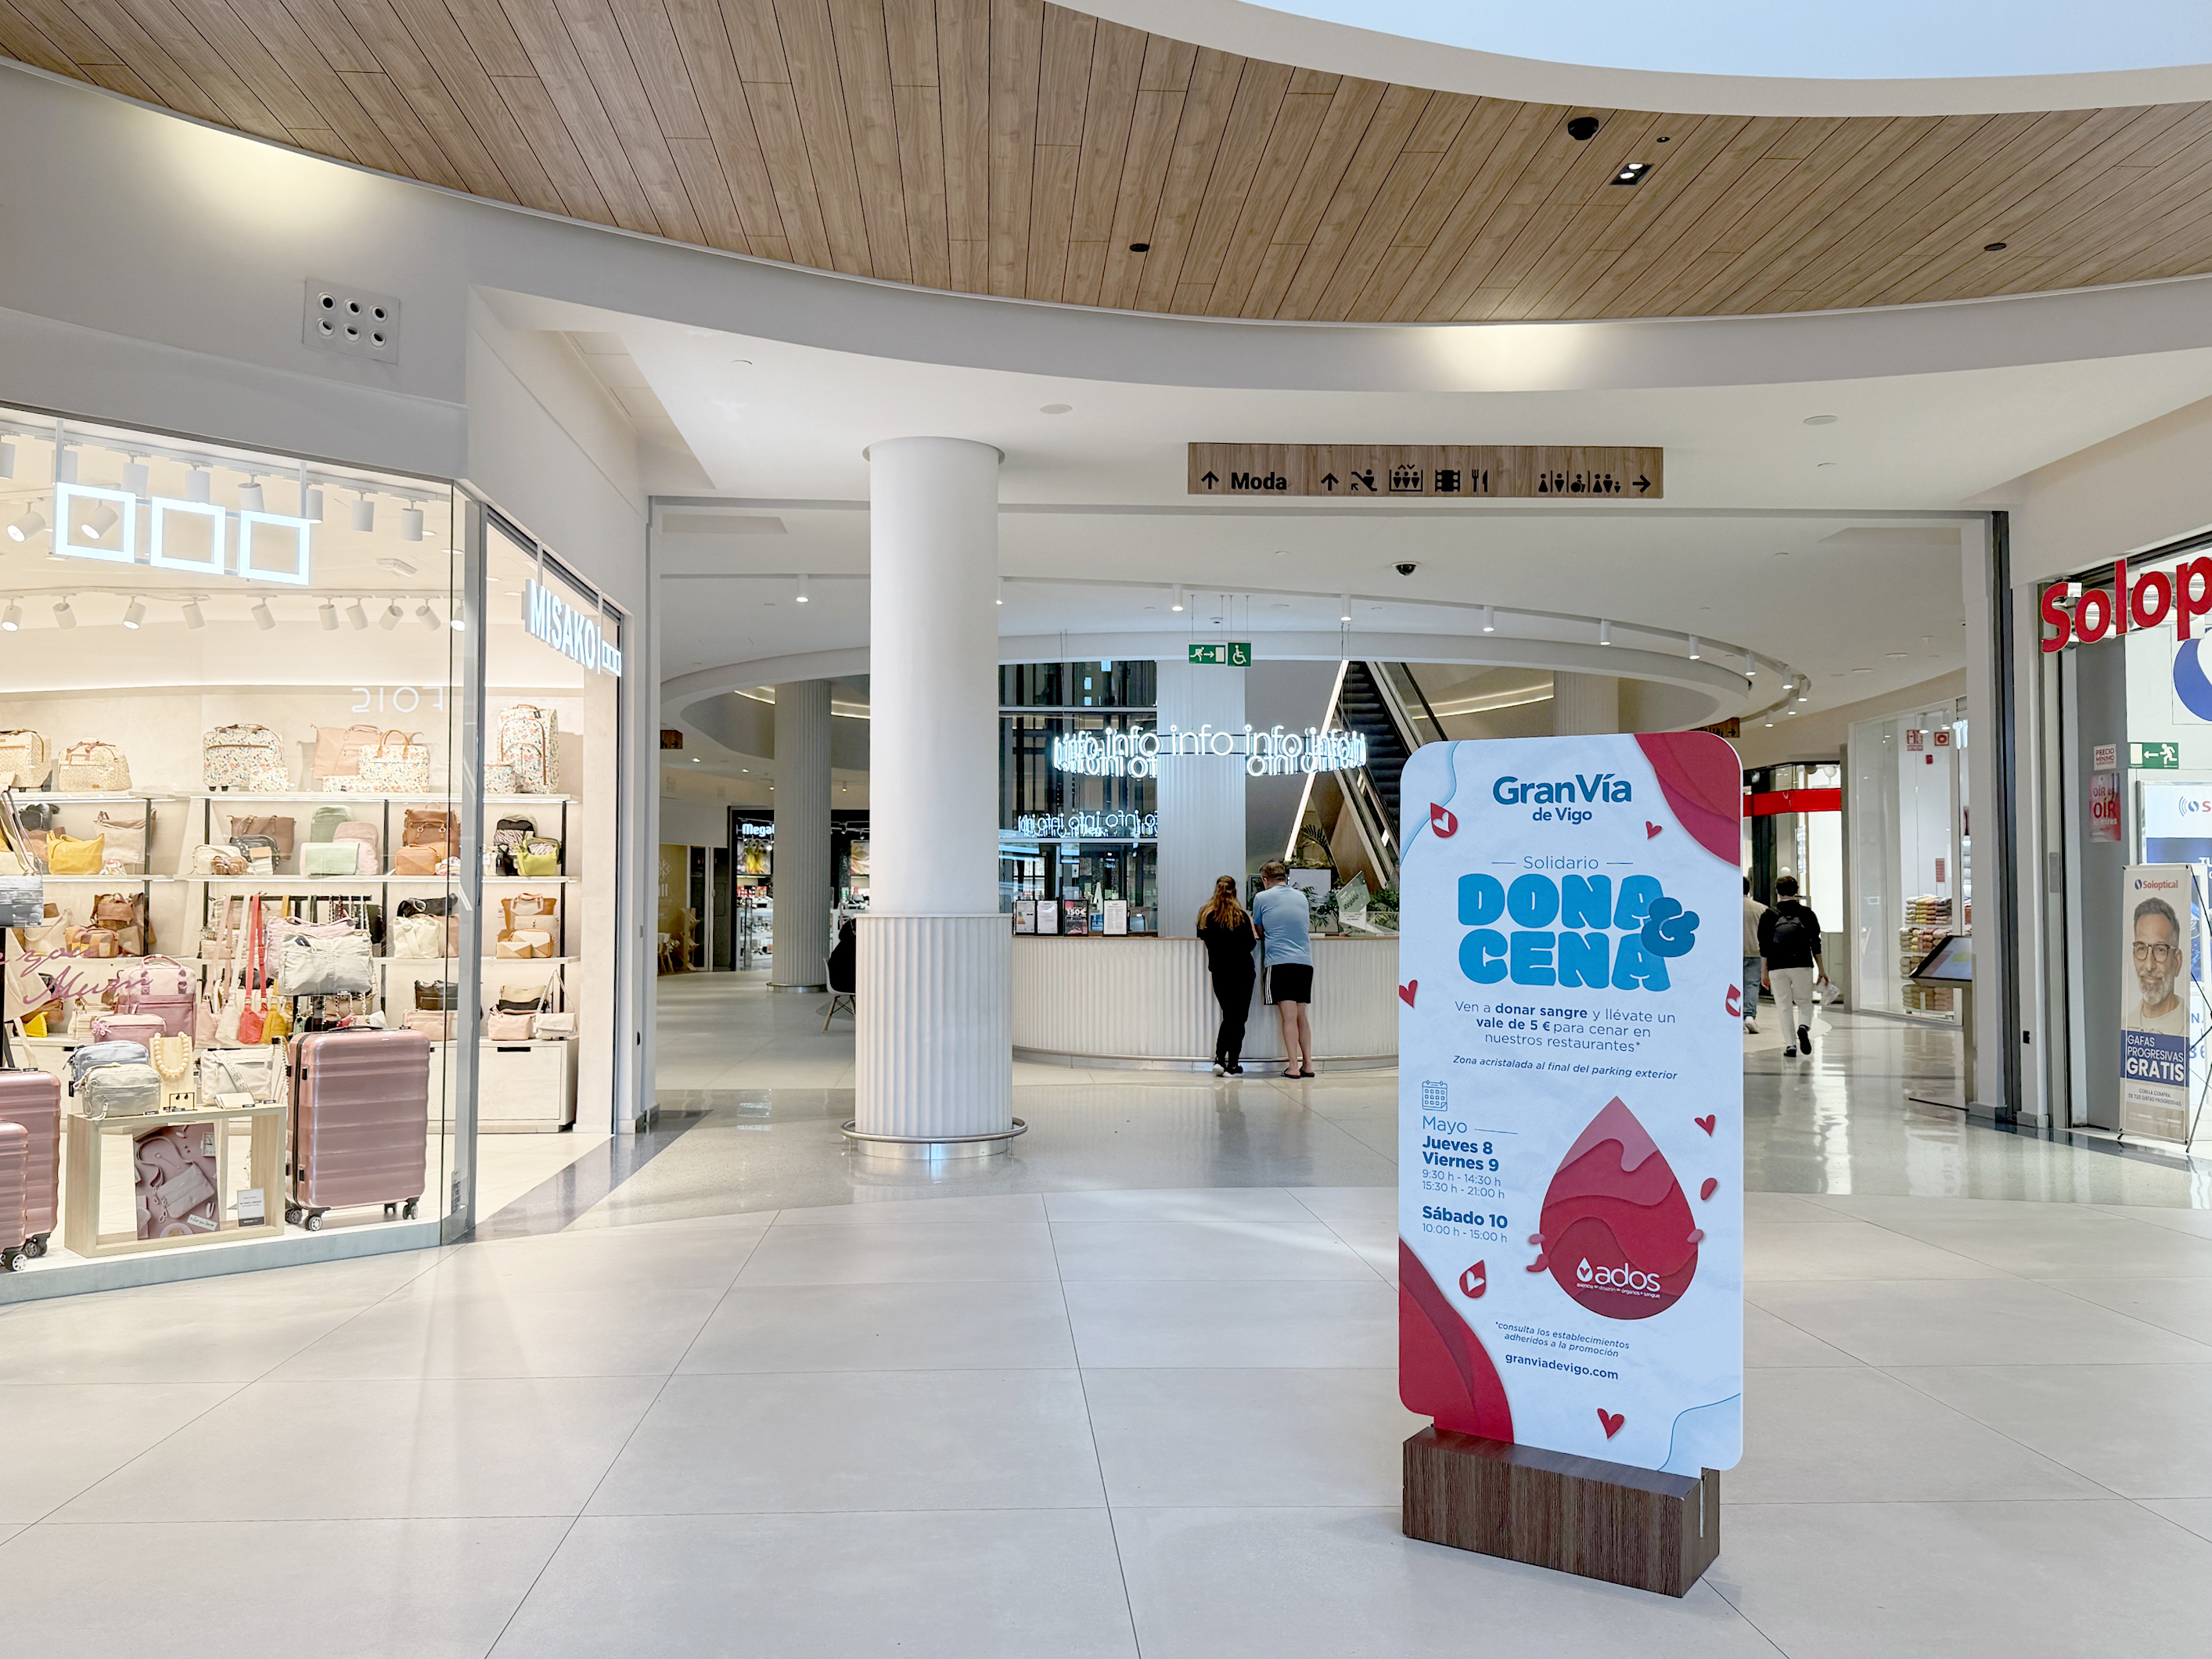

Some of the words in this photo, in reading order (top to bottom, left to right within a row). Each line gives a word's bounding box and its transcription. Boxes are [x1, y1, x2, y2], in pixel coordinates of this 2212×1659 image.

[1231, 472, 1287, 490] Moda
[2041, 556, 2212, 652] Solop
[530, 578, 595, 669] MISAKO
[1105, 725, 1160, 758] info
[1170, 724, 1234, 757] info
[1244, 724, 1303, 758] info
[2096, 747, 2114, 756] PRECIO
[1493, 774, 1631, 804] GranVía
[1533, 808, 1552, 821] de
[1556, 808, 1592, 825] Vigo
[1524, 856, 1598, 869] Solidario
[2143, 880, 2178, 891] Soloptical
[1458, 873, 1664, 930] DONA
[1458, 928, 1671, 991] CENA
[1455, 1002, 1478, 1012] Ven
[1495, 1003, 1535, 1015] donar
[1541, 1008, 1587, 1019] sangre
[1593, 1011, 1600, 1021] y
[1606, 1009, 1652, 1022] llévate
[1658, 1014, 1674, 1023] un
[1476, 1017, 1503, 1027] vale
[1509, 1019, 1525, 1029] de
[1530, 1020, 1538, 1030] 5
[1543, 1021, 1550, 1031] €
[1554, 1024, 1584, 1034] para
[1589, 1026, 1628, 1035] cenar
[1634, 1028, 1650, 1037] en
[1486, 1035, 1542, 1045] nuestros
[2127, 1035, 2155, 1047] GAFAS
[2127, 1046, 2184, 1063] PROGRESIVAS
[1453, 1056, 1476, 1064] Zona
[1480, 1060, 1533, 1068] acristalada
[1548, 1063, 1570, 1071] final
[1592, 1067, 1631, 1078] parking
[1635, 1071, 1678, 1079] exterior
[2127, 1057, 2185, 1081] GRATIS
[1423, 1116, 1467, 1135] Mayo
[1423, 1135, 1478, 1153] Jueves
[1483, 1142, 1492, 1154] 8
[1423, 1151, 1484, 1171] Viernes
[1489, 1159, 1498, 1171] 9
[1423, 1169, 1444, 1180] 9:30
[1448, 1171, 1454, 1181] h
[1465, 1174, 1491, 1185] 14:30
[1495, 1177, 1501, 1186] h
[1423, 1181, 1448, 1192] 15:30
[1451, 1184, 1457, 1193] h
[1468, 1186, 1494, 1197] 21:00
[1498, 1189, 1505, 1199] h
[1423, 1206, 1484, 1225] Sábado
[1489, 1215, 1508, 1228] 10
[1423, 1223, 1450, 1235] 10:00
[1454, 1227, 1459, 1236] h
[1470, 1229, 1498, 1241] 15:00
[1501, 1233, 1507, 1243] h
[1594, 1263, 1660, 1292] ados
[1505, 1333, 1548, 1346] adheridos
[1569, 1343, 1619, 1357] promoción
[1552, 1331, 1630, 1350] establecimientos
[1505, 1354, 1618, 1380] granviadevigo.com
